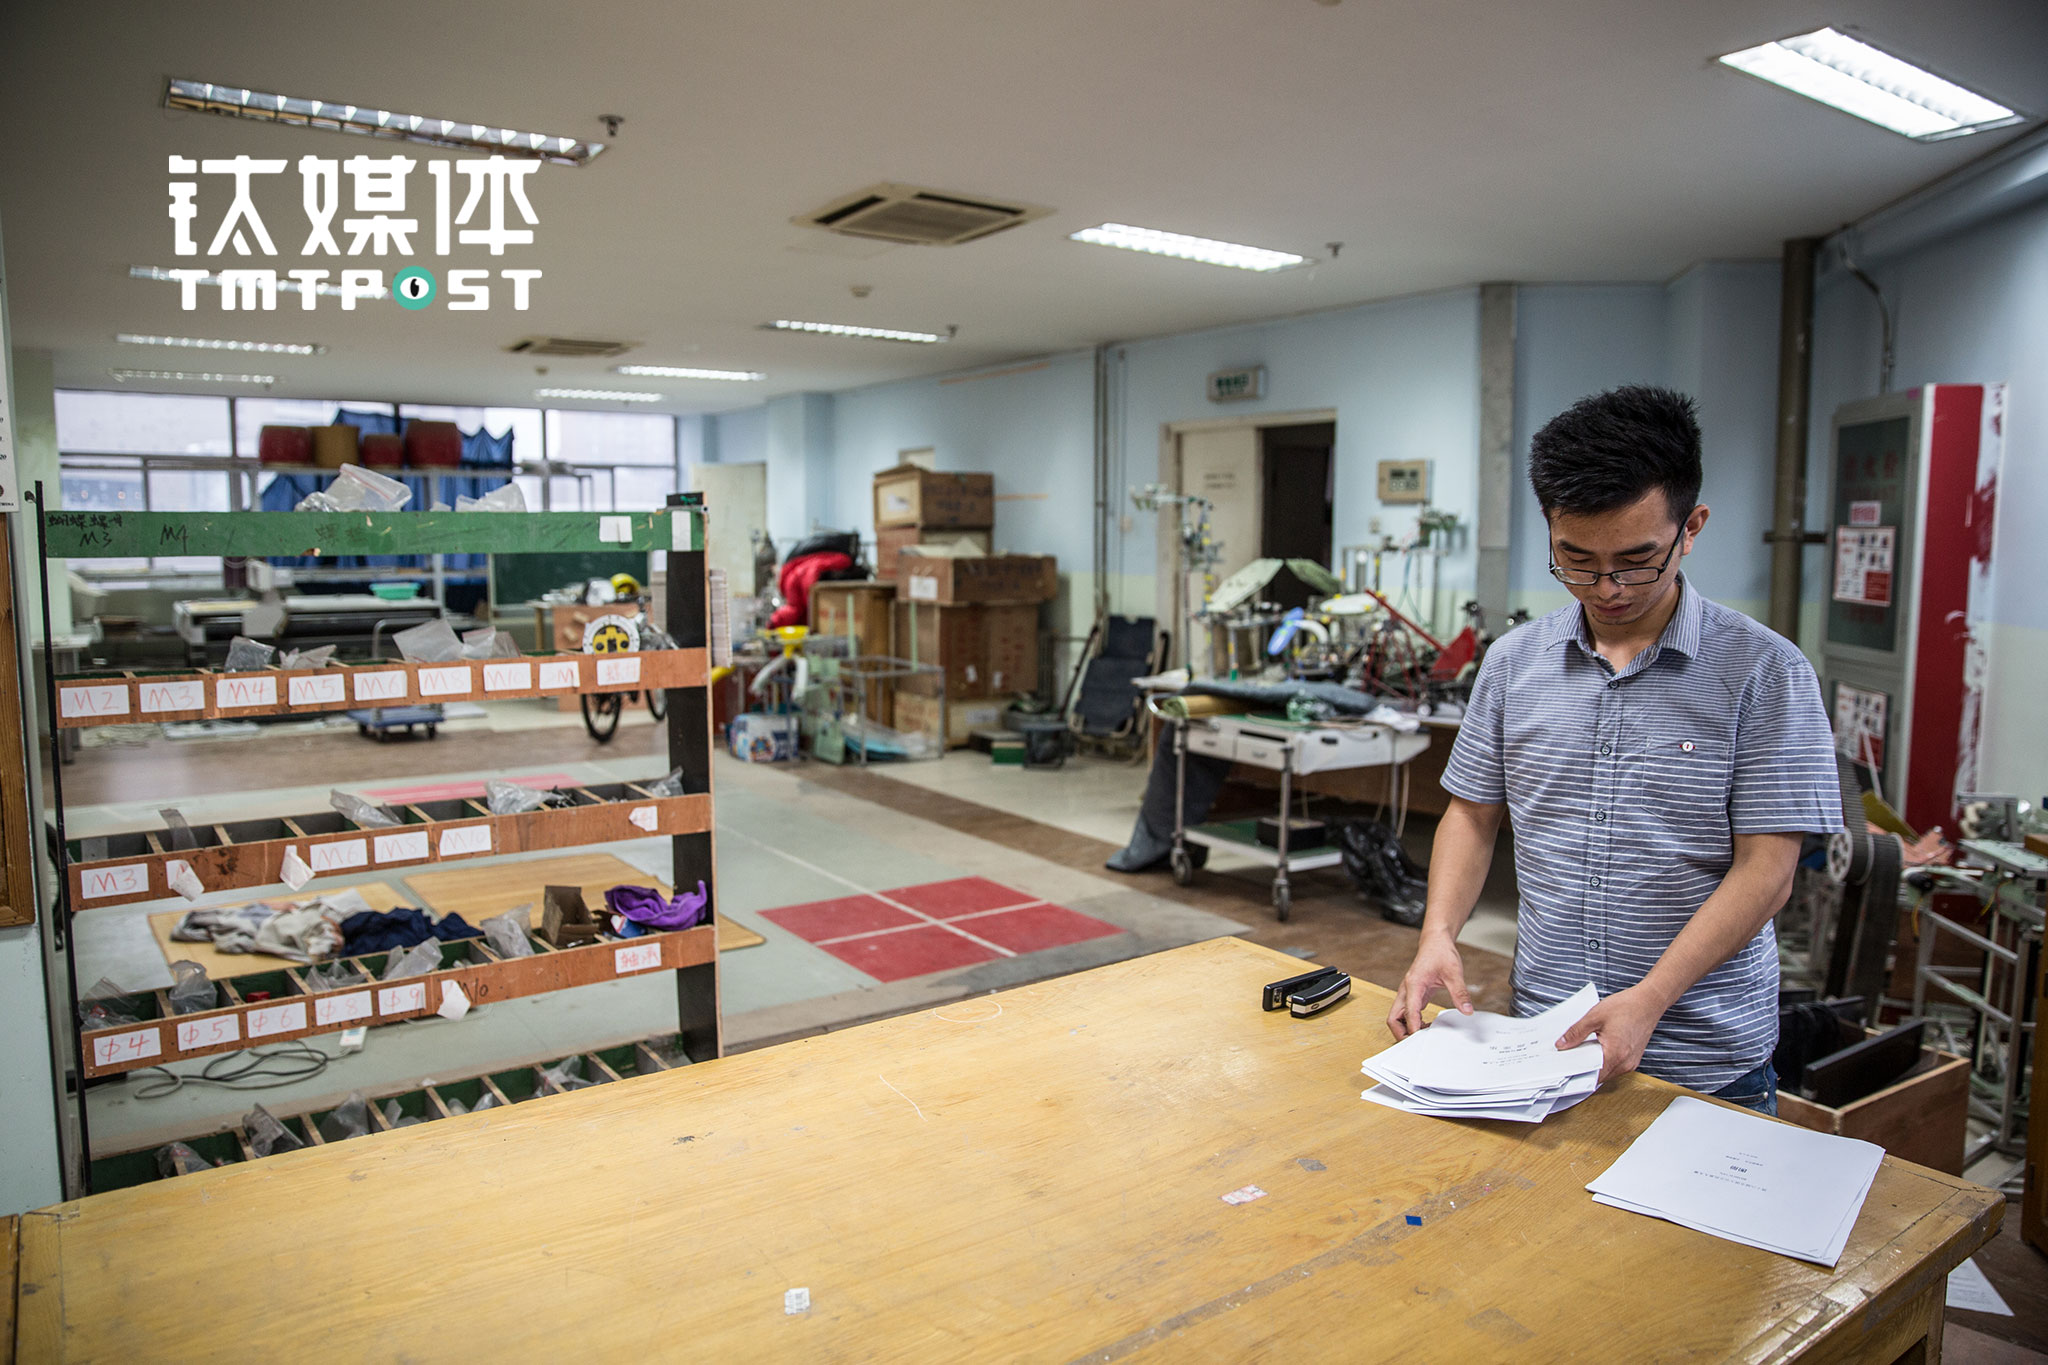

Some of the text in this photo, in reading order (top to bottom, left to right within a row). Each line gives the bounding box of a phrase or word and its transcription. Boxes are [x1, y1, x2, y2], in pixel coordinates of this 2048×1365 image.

[79, 531, 112, 548] M3
[160, 524, 189, 553] M4
[294, 678, 335, 700] M5
[360, 676, 399, 697] M6
[423, 669, 464, 690] M8
[72, 690, 119, 714] M2
[149, 686, 194, 710] M3
[227, 682, 267, 704] M4
[316, 848, 359, 869] M6
[382, 839, 416, 859] M8
[90, 871, 137, 894] M3
